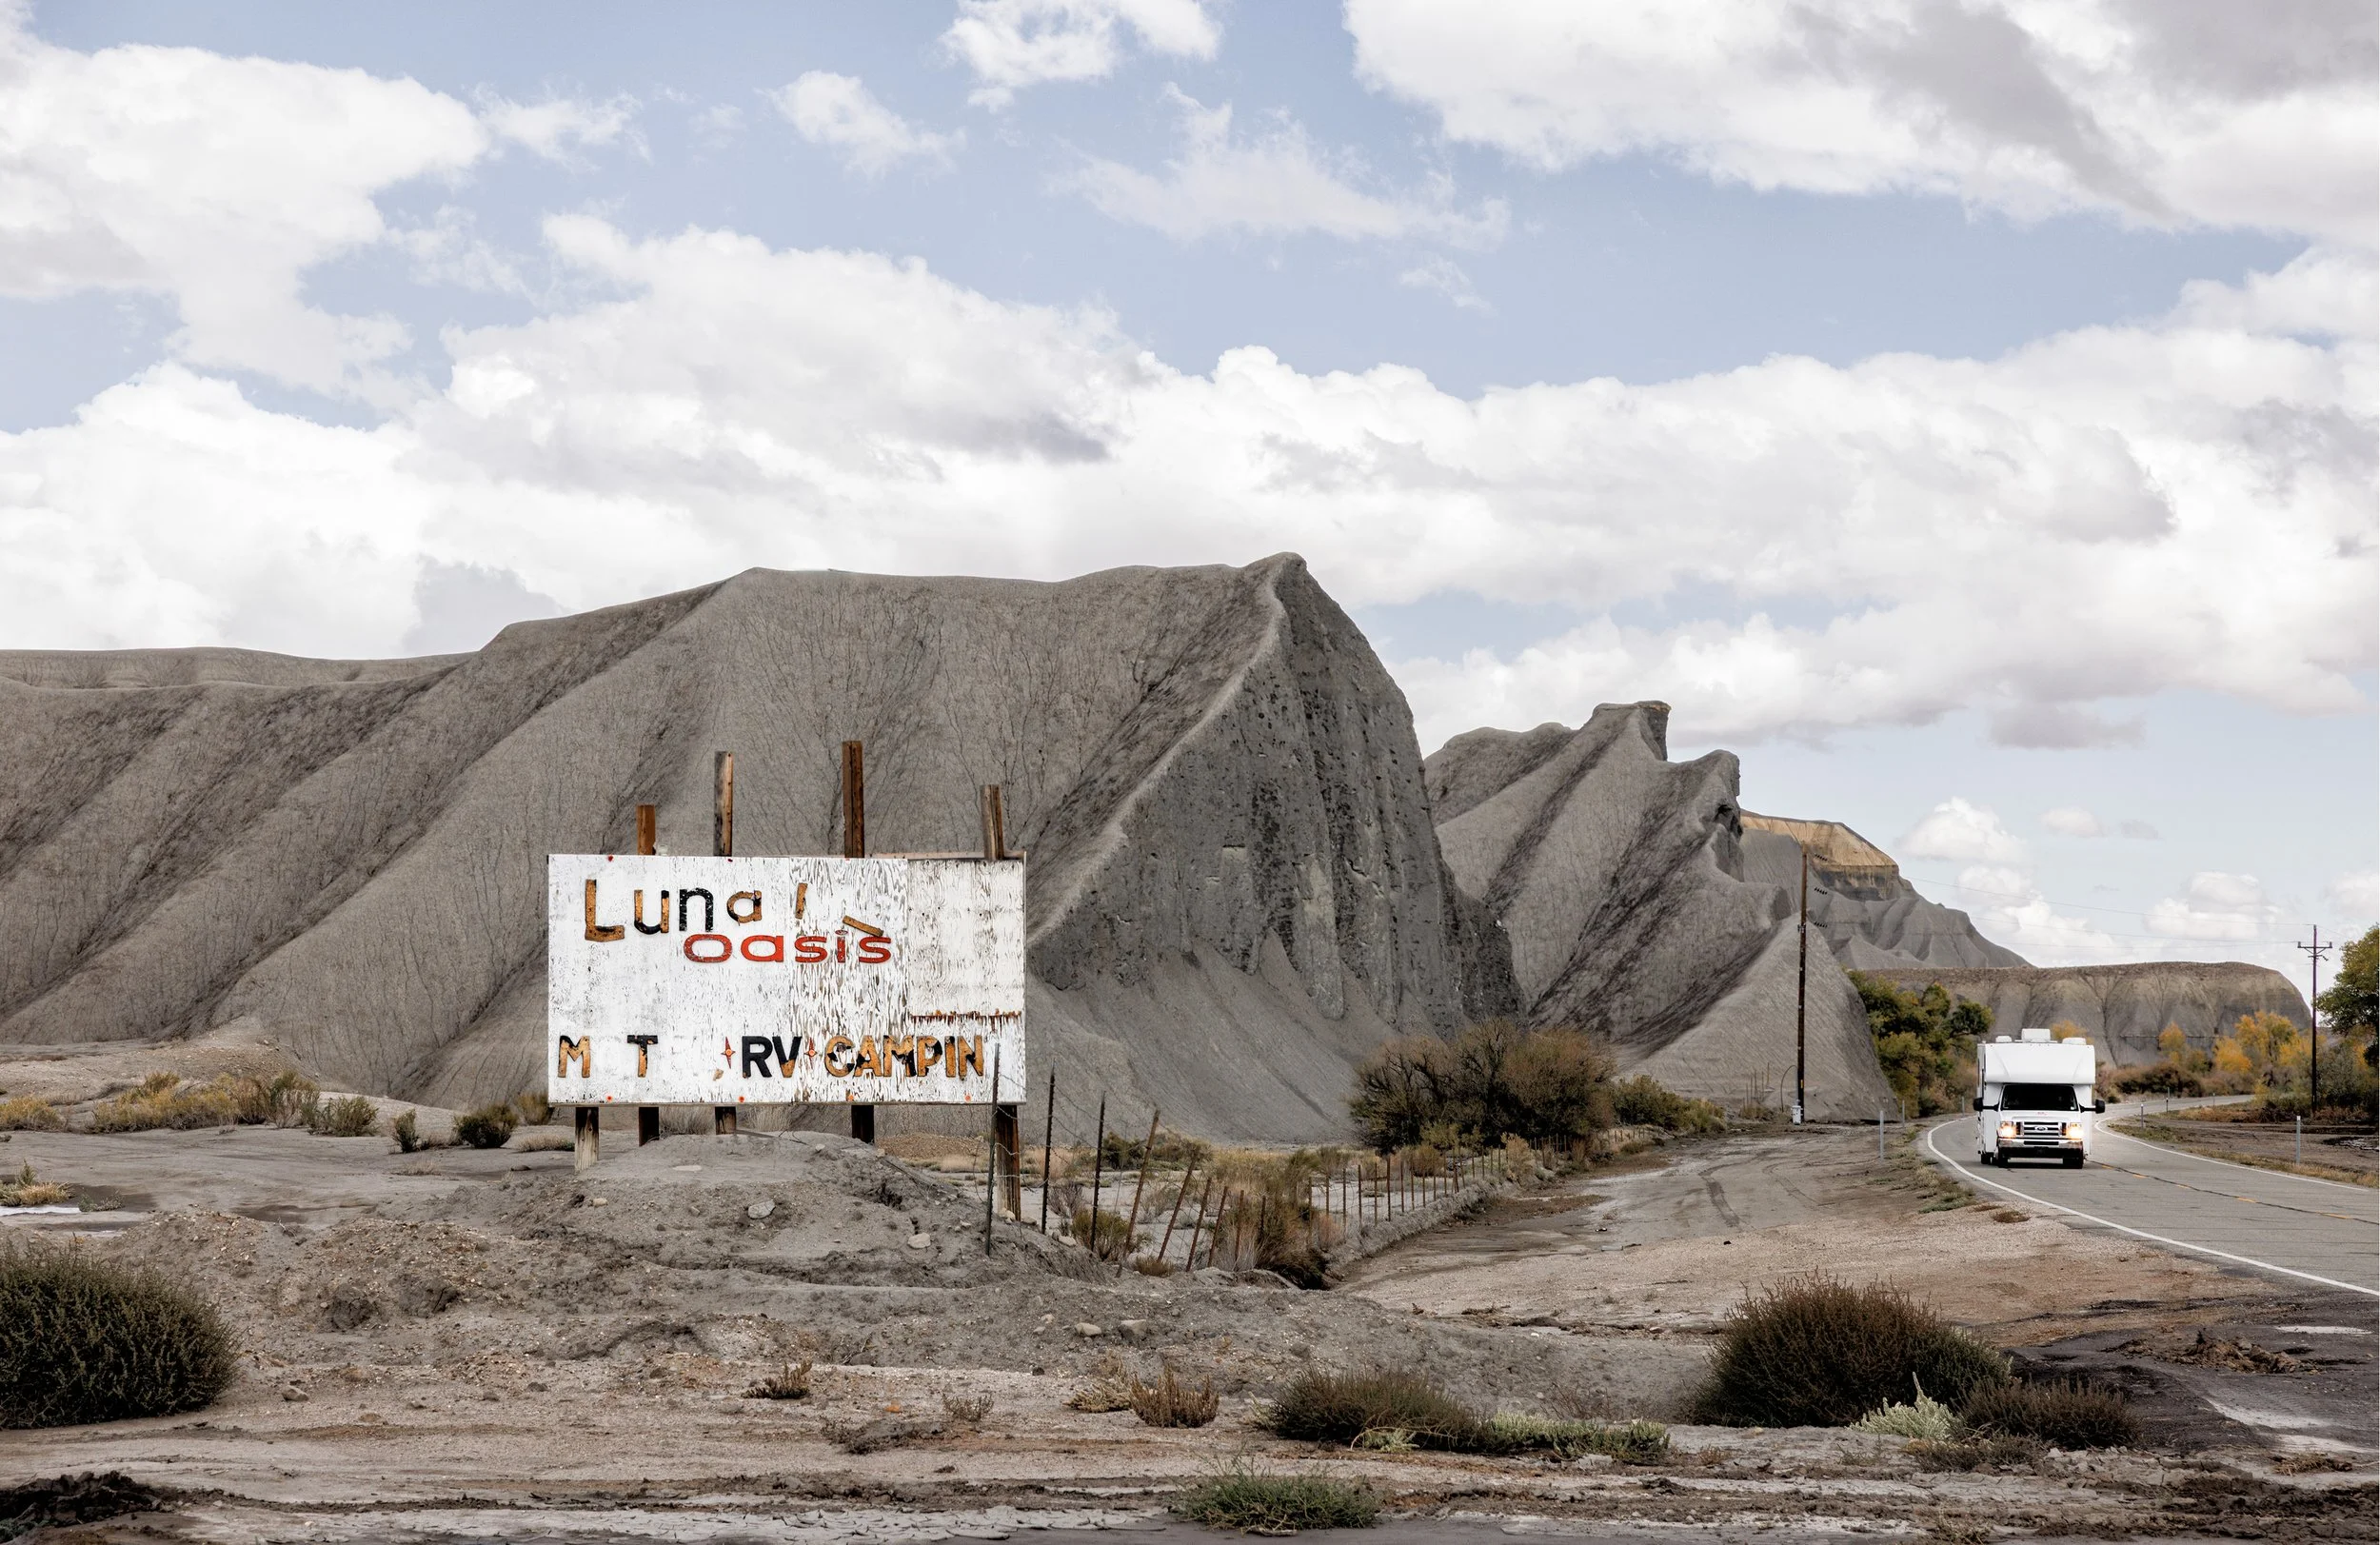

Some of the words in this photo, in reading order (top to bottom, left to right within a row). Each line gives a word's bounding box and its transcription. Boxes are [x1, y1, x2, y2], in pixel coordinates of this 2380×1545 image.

[585, 879, 763, 942] Luna
[684, 929, 892, 963] oasis
[742, 1035, 803, 1079] RV
